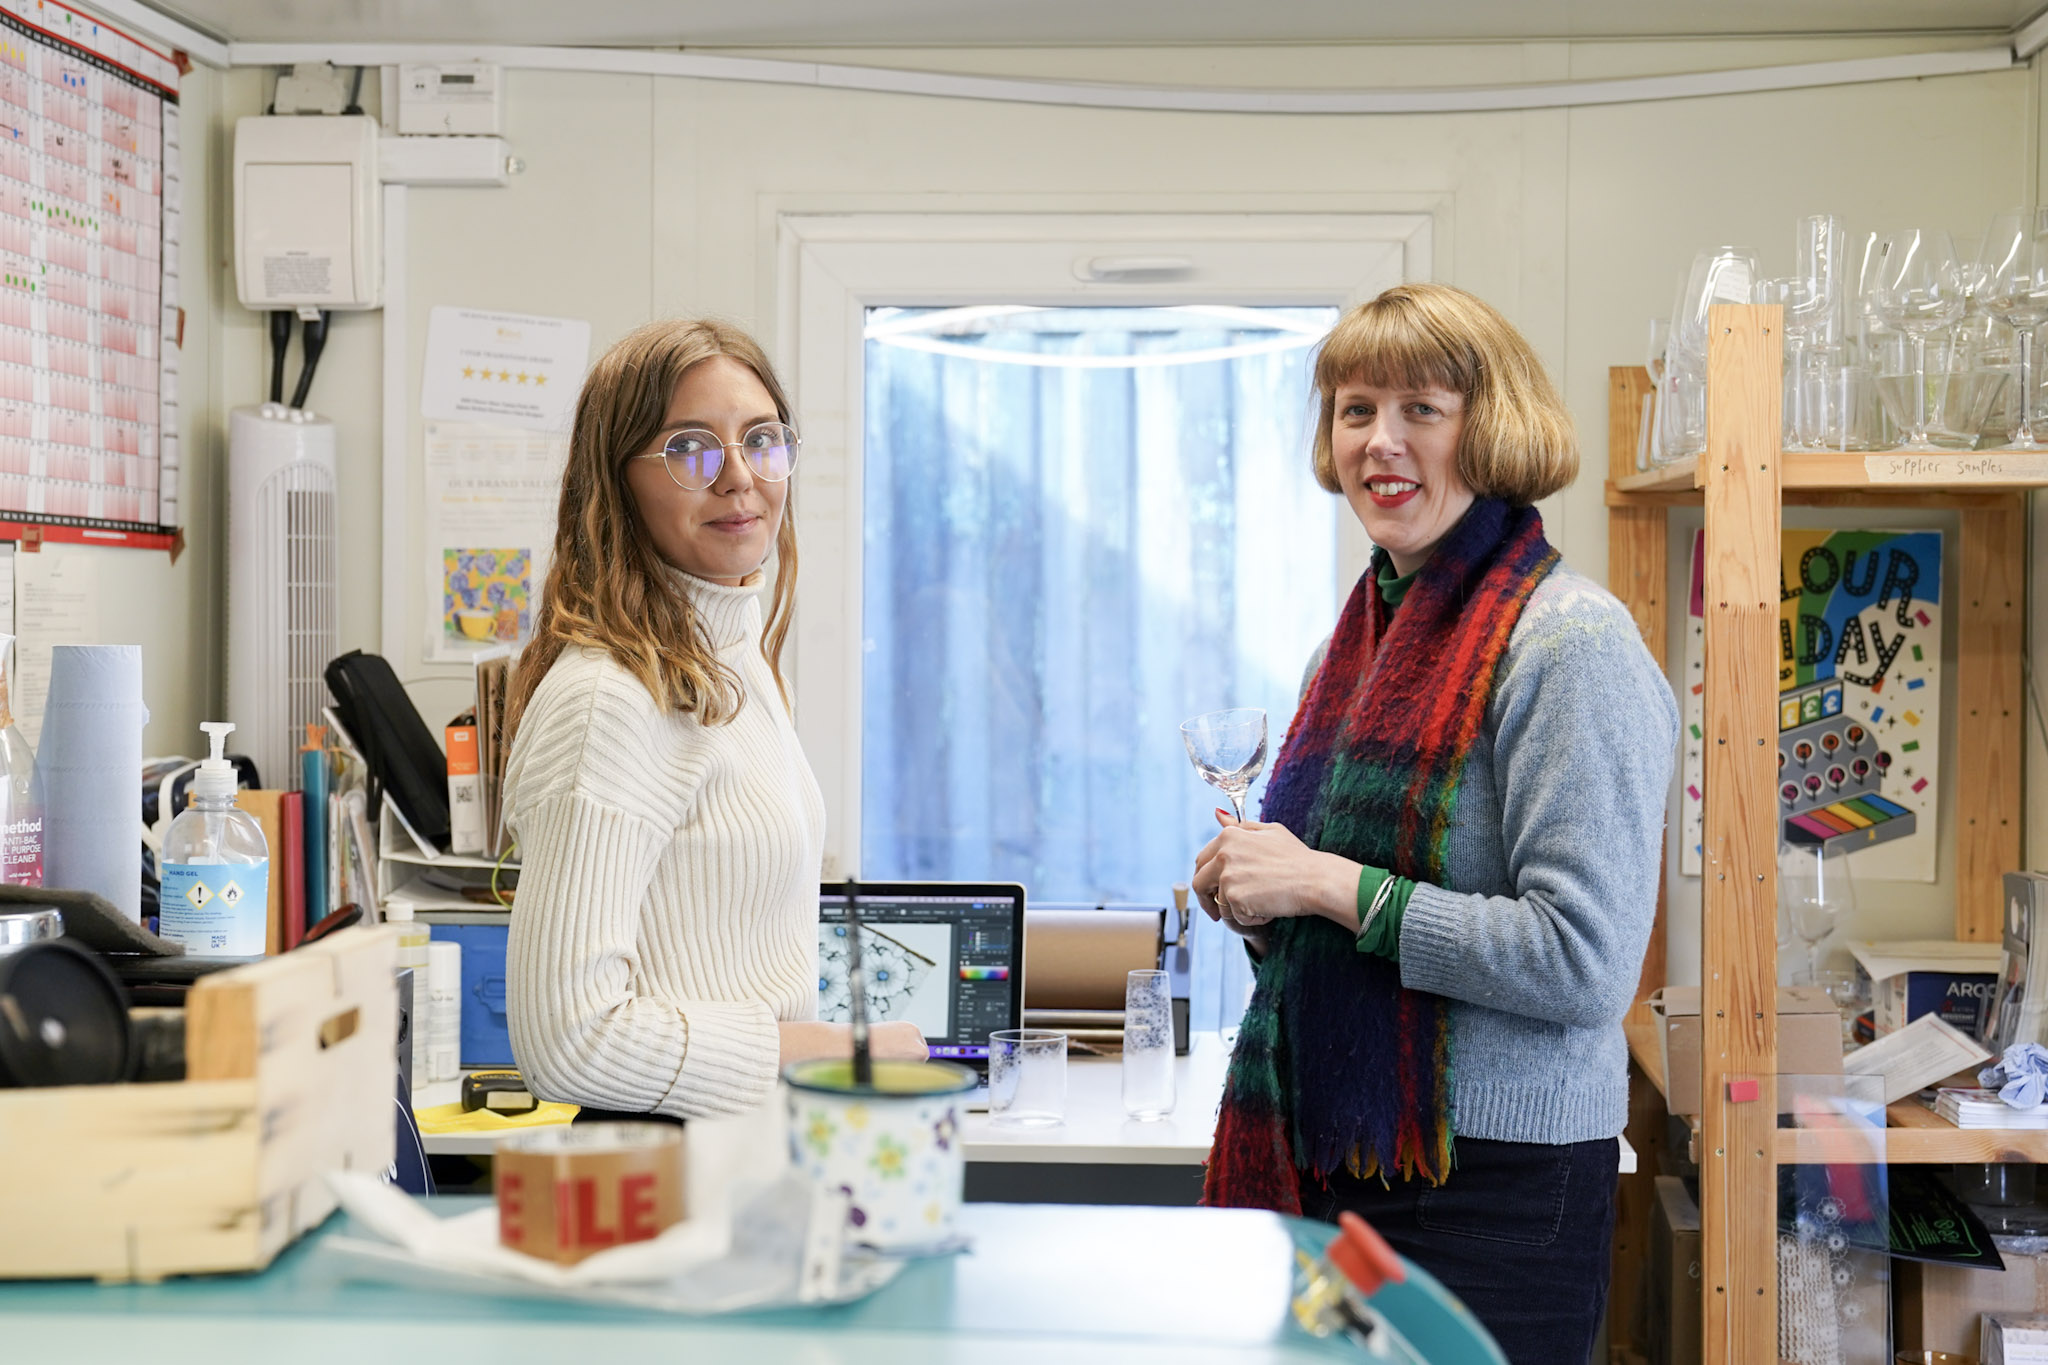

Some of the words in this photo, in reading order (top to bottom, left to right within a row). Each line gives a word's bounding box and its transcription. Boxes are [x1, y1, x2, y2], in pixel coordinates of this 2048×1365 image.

[1780, 546, 1919, 628] LOUR
[1779, 614, 1906, 686] IDAY
[1779, 726, 1864, 768] HOP
[2, 853, 37, 865] CLEANER
[11, 844, 41, 854] PURPOSE
